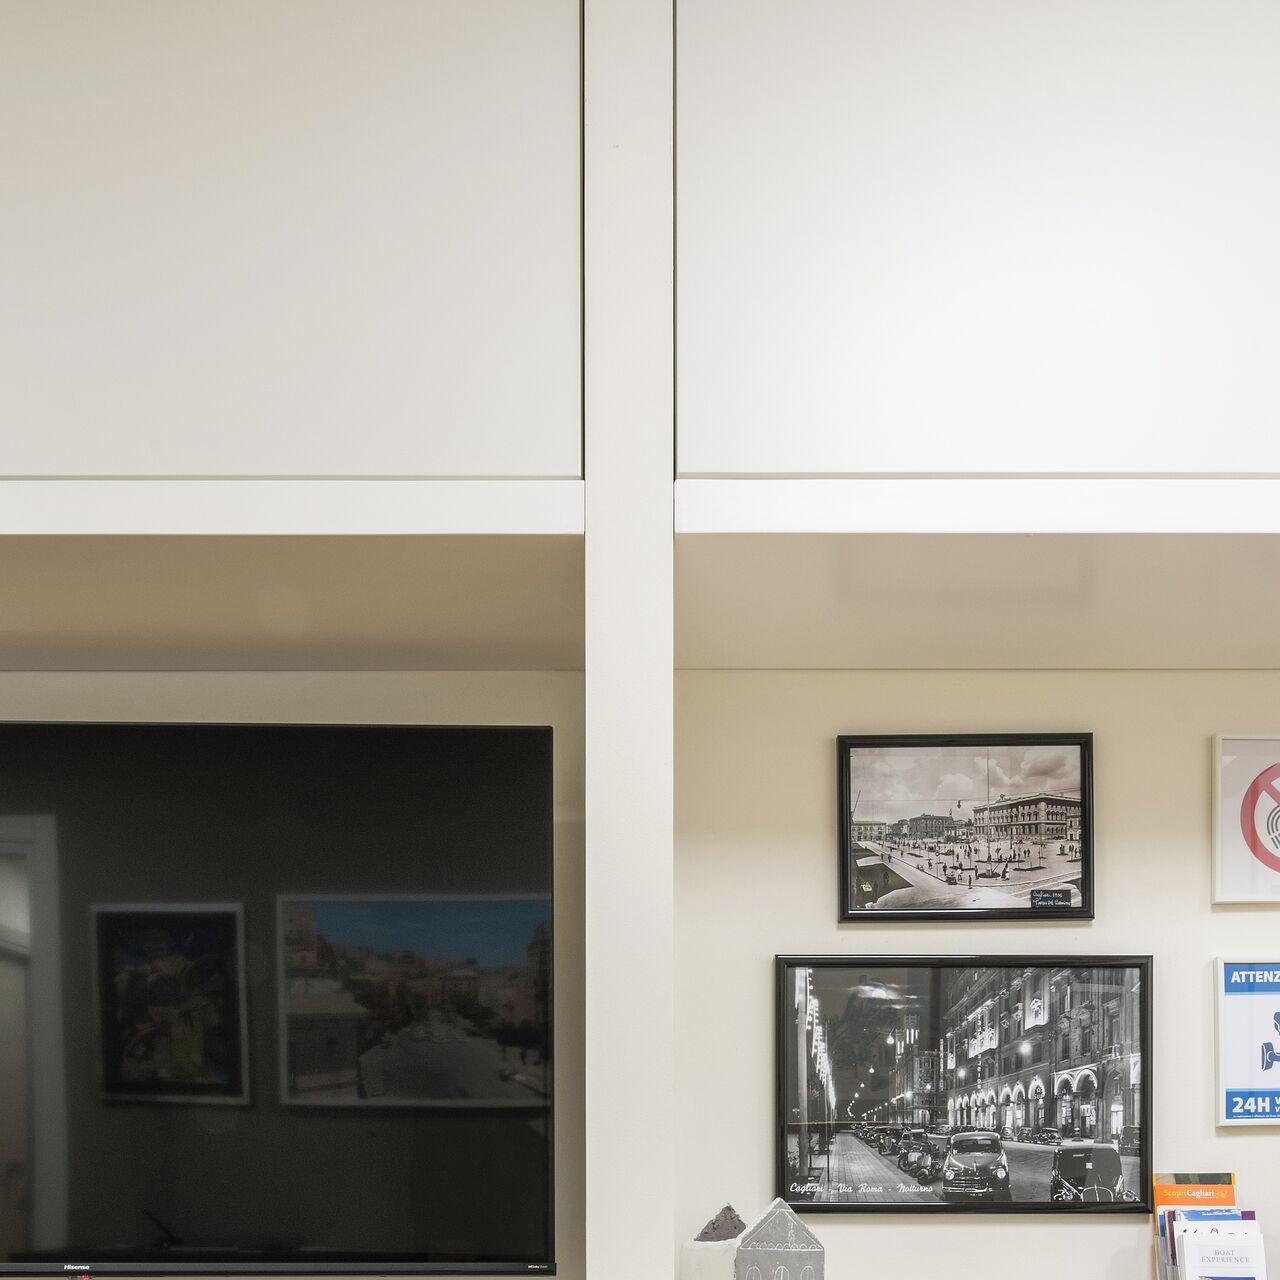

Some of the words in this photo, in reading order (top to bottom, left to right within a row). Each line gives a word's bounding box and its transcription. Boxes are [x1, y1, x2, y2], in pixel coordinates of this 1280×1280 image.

[1232, 1096, 1271, 1113] 24H
[790, 1182, 825, 1195] Cagliari
[837, 1183, 853, 1193] Via
[858, 1182, 883, 1193] Roma
[897, 1182, 934, 1193] Notturno
